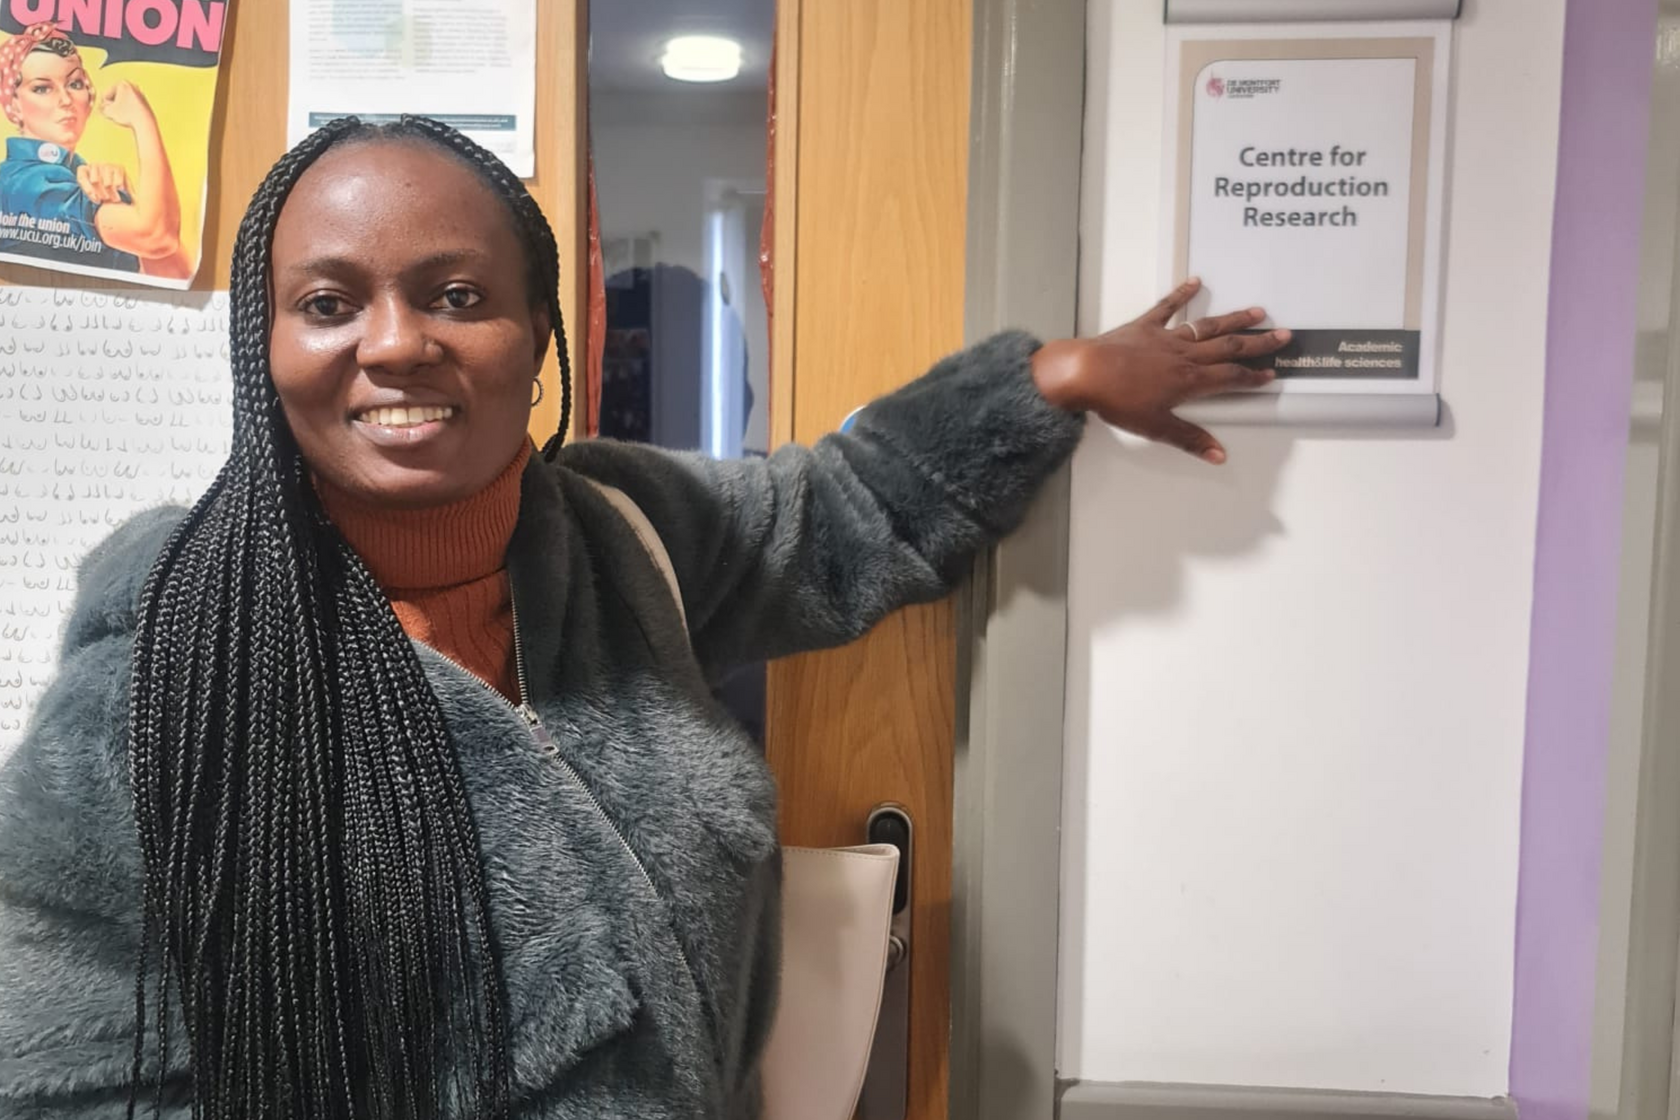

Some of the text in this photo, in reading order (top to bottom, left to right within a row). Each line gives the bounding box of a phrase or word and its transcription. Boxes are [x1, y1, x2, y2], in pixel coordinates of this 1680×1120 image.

[9, 0, 225, 53] UNION
[1226, 86, 1280, 94] UNIVERSITY
[1239, 145, 1366, 167] Centre for
[1214, 176, 1389, 202] Reproduction
[18, 212, 36, 228] the
[38, 217, 70, 234] union
[1243, 205, 1357, 227] Research
[1338, 341, 1403, 353] Academic
[1344, 356, 1402, 369] sciences
